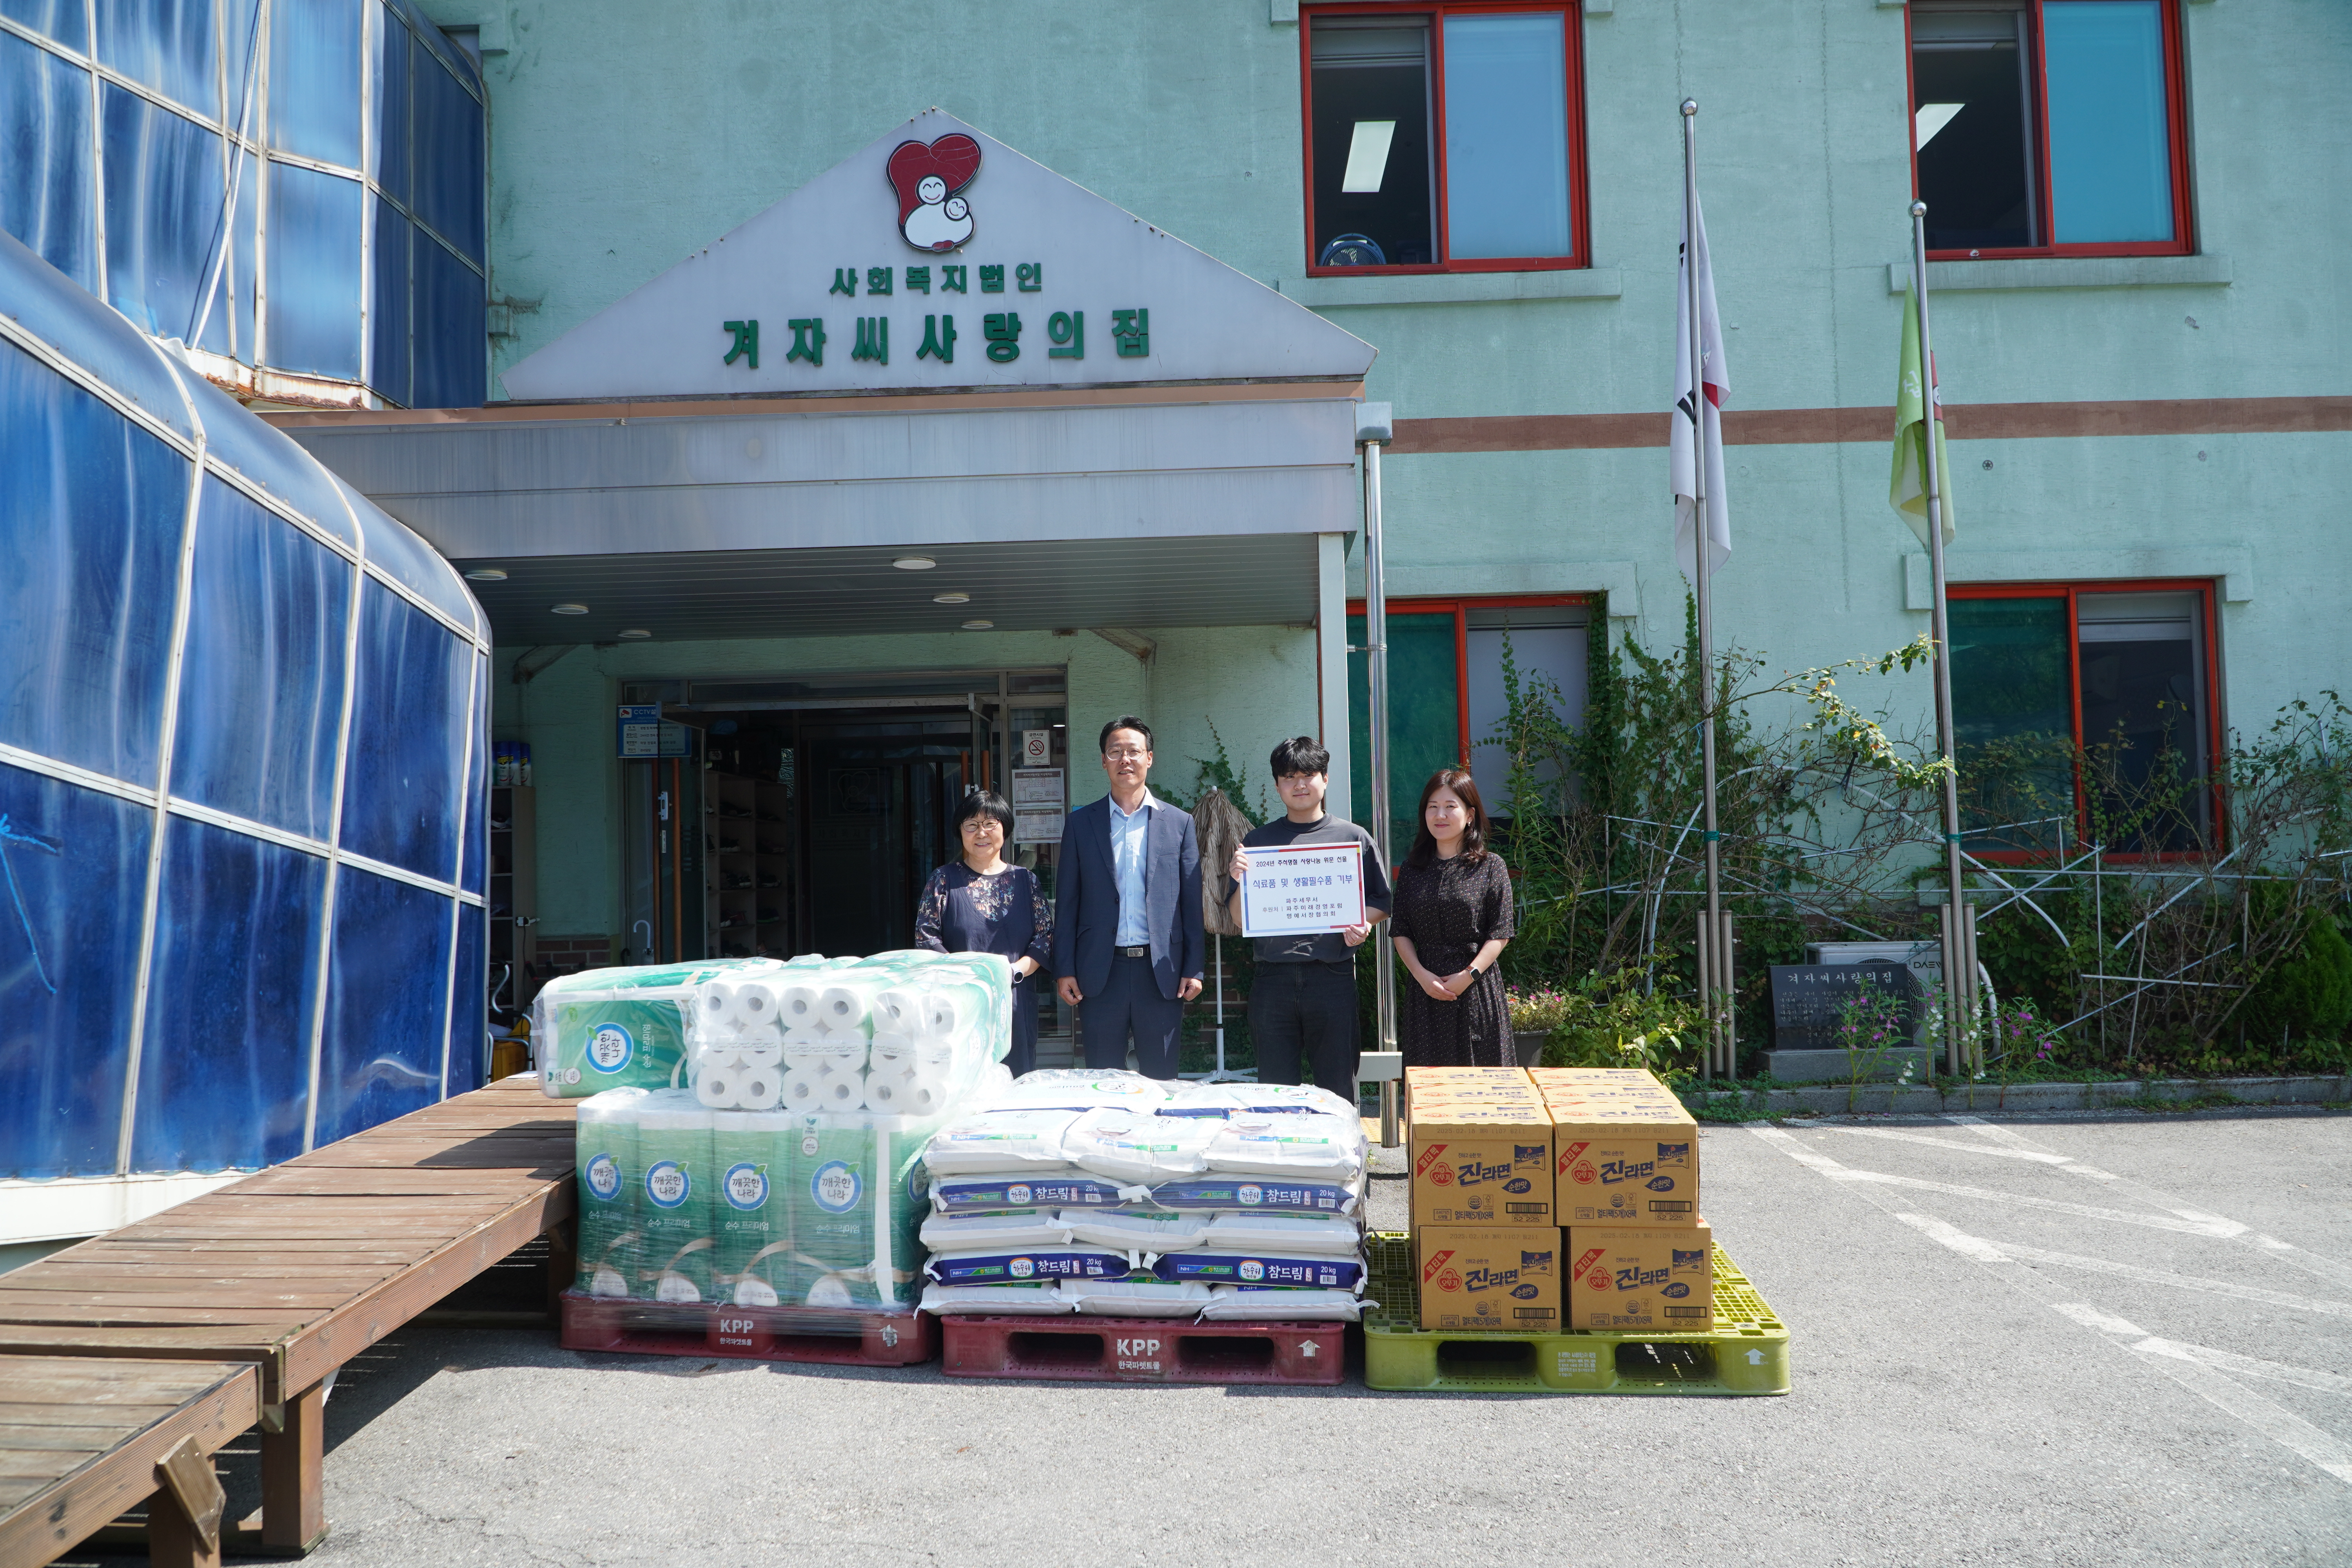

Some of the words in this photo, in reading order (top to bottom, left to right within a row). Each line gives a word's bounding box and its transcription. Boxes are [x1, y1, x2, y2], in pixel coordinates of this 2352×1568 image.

[829, 263, 1042, 296] 사회복지법인
[723, 308, 1149, 368] 겨자씨사랑의집
[1253, 879, 1276, 889] 식료품
[1281, 878, 1288, 887] 및
[1294, 876, 1332, 887] 생활필수품
[1337, 875, 1353, 884] 기부
[1788, 972, 1891, 985] 겨자씨사랑의집
[642, 1024, 651, 1052] 프리미엄
[600, 1033, 610, 1063] 깨끗한
[612, 1038, 621, 1058] 나라
[642, 1054, 651, 1068] 순수
[1419, 1146, 1439, 1168] 멀티팩
[1519, 1153, 1539, 1161] 진라면
[1561, 1144, 1581, 1166] 멀티팩
[1457, 1162, 1512, 1187] 진라면
[1600, 1160, 1654, 1185] 진라면
[654, 1175, 681, 1186] 깨끗한
[732, 1177, 760, 1188] 깨끗한
[822, 1176, 851, 1189] 깨끗한
[1508, 1181, 1527, 1191] 순한맛
[1651, 1179, 1671, 1190] 순한맛
[660, 1187, 677, 1196] 나라
[737, 1189, 756, 1198] 나라
[827, 1190, 845, 1200] 나라
[1035, 1187, 1068, 1200] 참드림
[1241, 1191, 1259, 1199] 한수위
[1267, 1189, 1301, 1204] 참드림
[588, 1210, 600, 1219] 순수
[1455, 1210, 1494, 1220] 멀티팩(5개)X8팩
[1597, 1209, 1637, 1218] 멀티팩(5개)X8팩
[648, 1218, 661, 1227] 순수
[663, 1219, 690, 1228] 프리미엄
[725, 1221, 739, 1230] 순수
[741, 1222, 769, 1231] 프리미엄
[816, 1225, 831, 1233] 순수
[833, 1224, 860, 1233] 프리미엄
[1038, 1260, 1070, 1273] 참드림
[1426, 1252, 1447, 1274] 멀티팩
[1575, 1251, 1597, 1273] 멀티팩
[1678, 1258, 1698, 1267] 진라면
[1243, 1266, 1260, 1275] 한수위
[1268, 1265, 1303, 1280] 참드림
[1465, 1268, 1519, 1293] 진라면
[1615, 1266, 1670, 1292] 진라면
[1515, 1287, 1535, 1298] 순한맛
[1666, 1285, 1686, 1296] 순한맛
[720, 1319, 754, 1334] KPP
[1463, 1316, 1501, 1326] 멀티팩(5개)X8팩
[1613, 1316, 1652, 1325] 멀티팩(5개)X8팩
[1117, 1339, 1160, 1356] KPP
[1118, 1361, 1160, 1370] 한국파렛트풀
